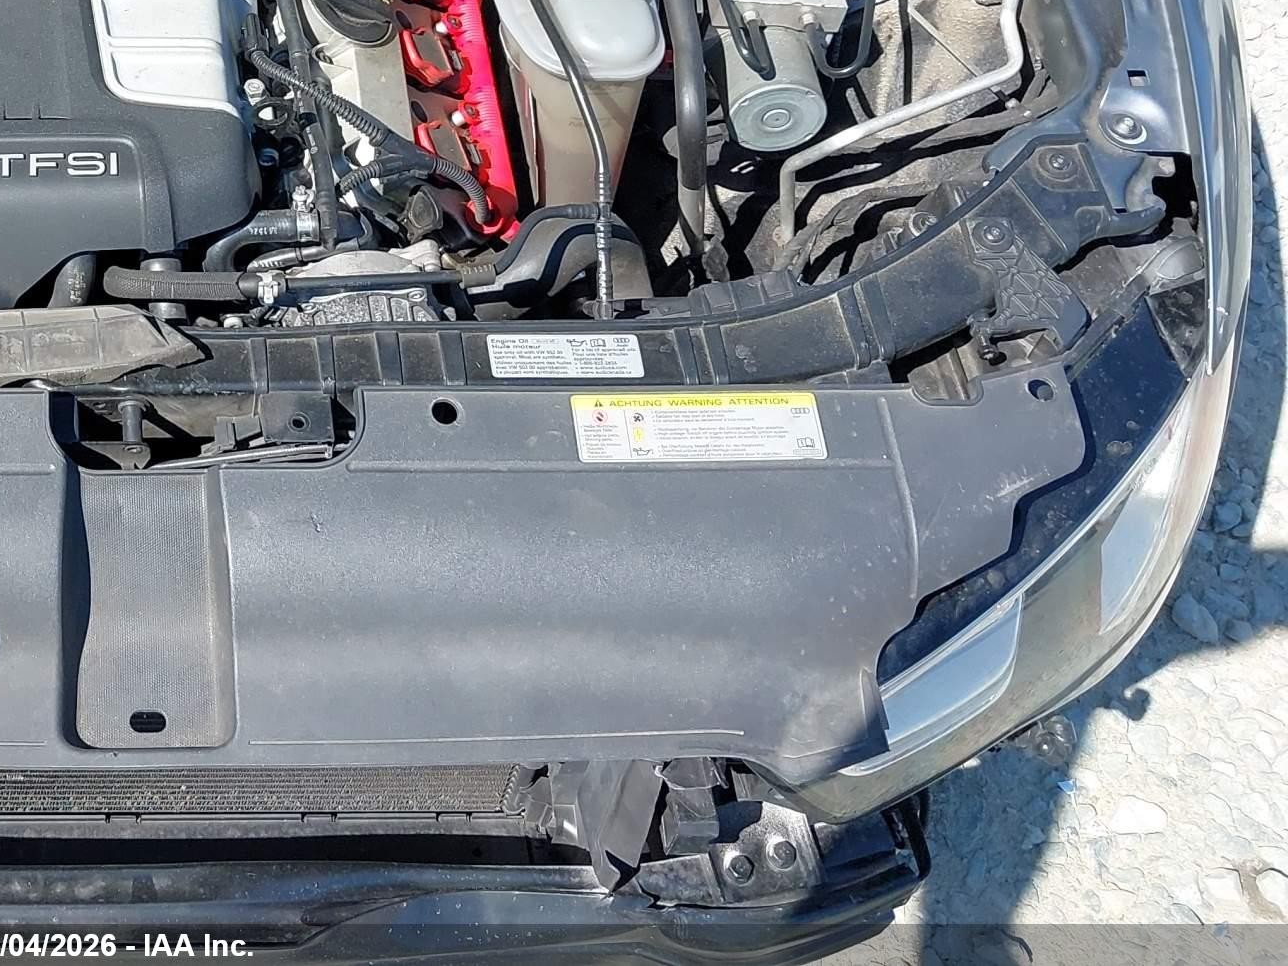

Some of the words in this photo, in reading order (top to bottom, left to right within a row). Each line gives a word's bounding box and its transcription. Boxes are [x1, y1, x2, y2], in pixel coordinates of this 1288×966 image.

[609, 399, 662, 407] ACHTUNG
[668, 398, 722, 406] WARNING
[729, 397, 789, 405] ATTENTION
